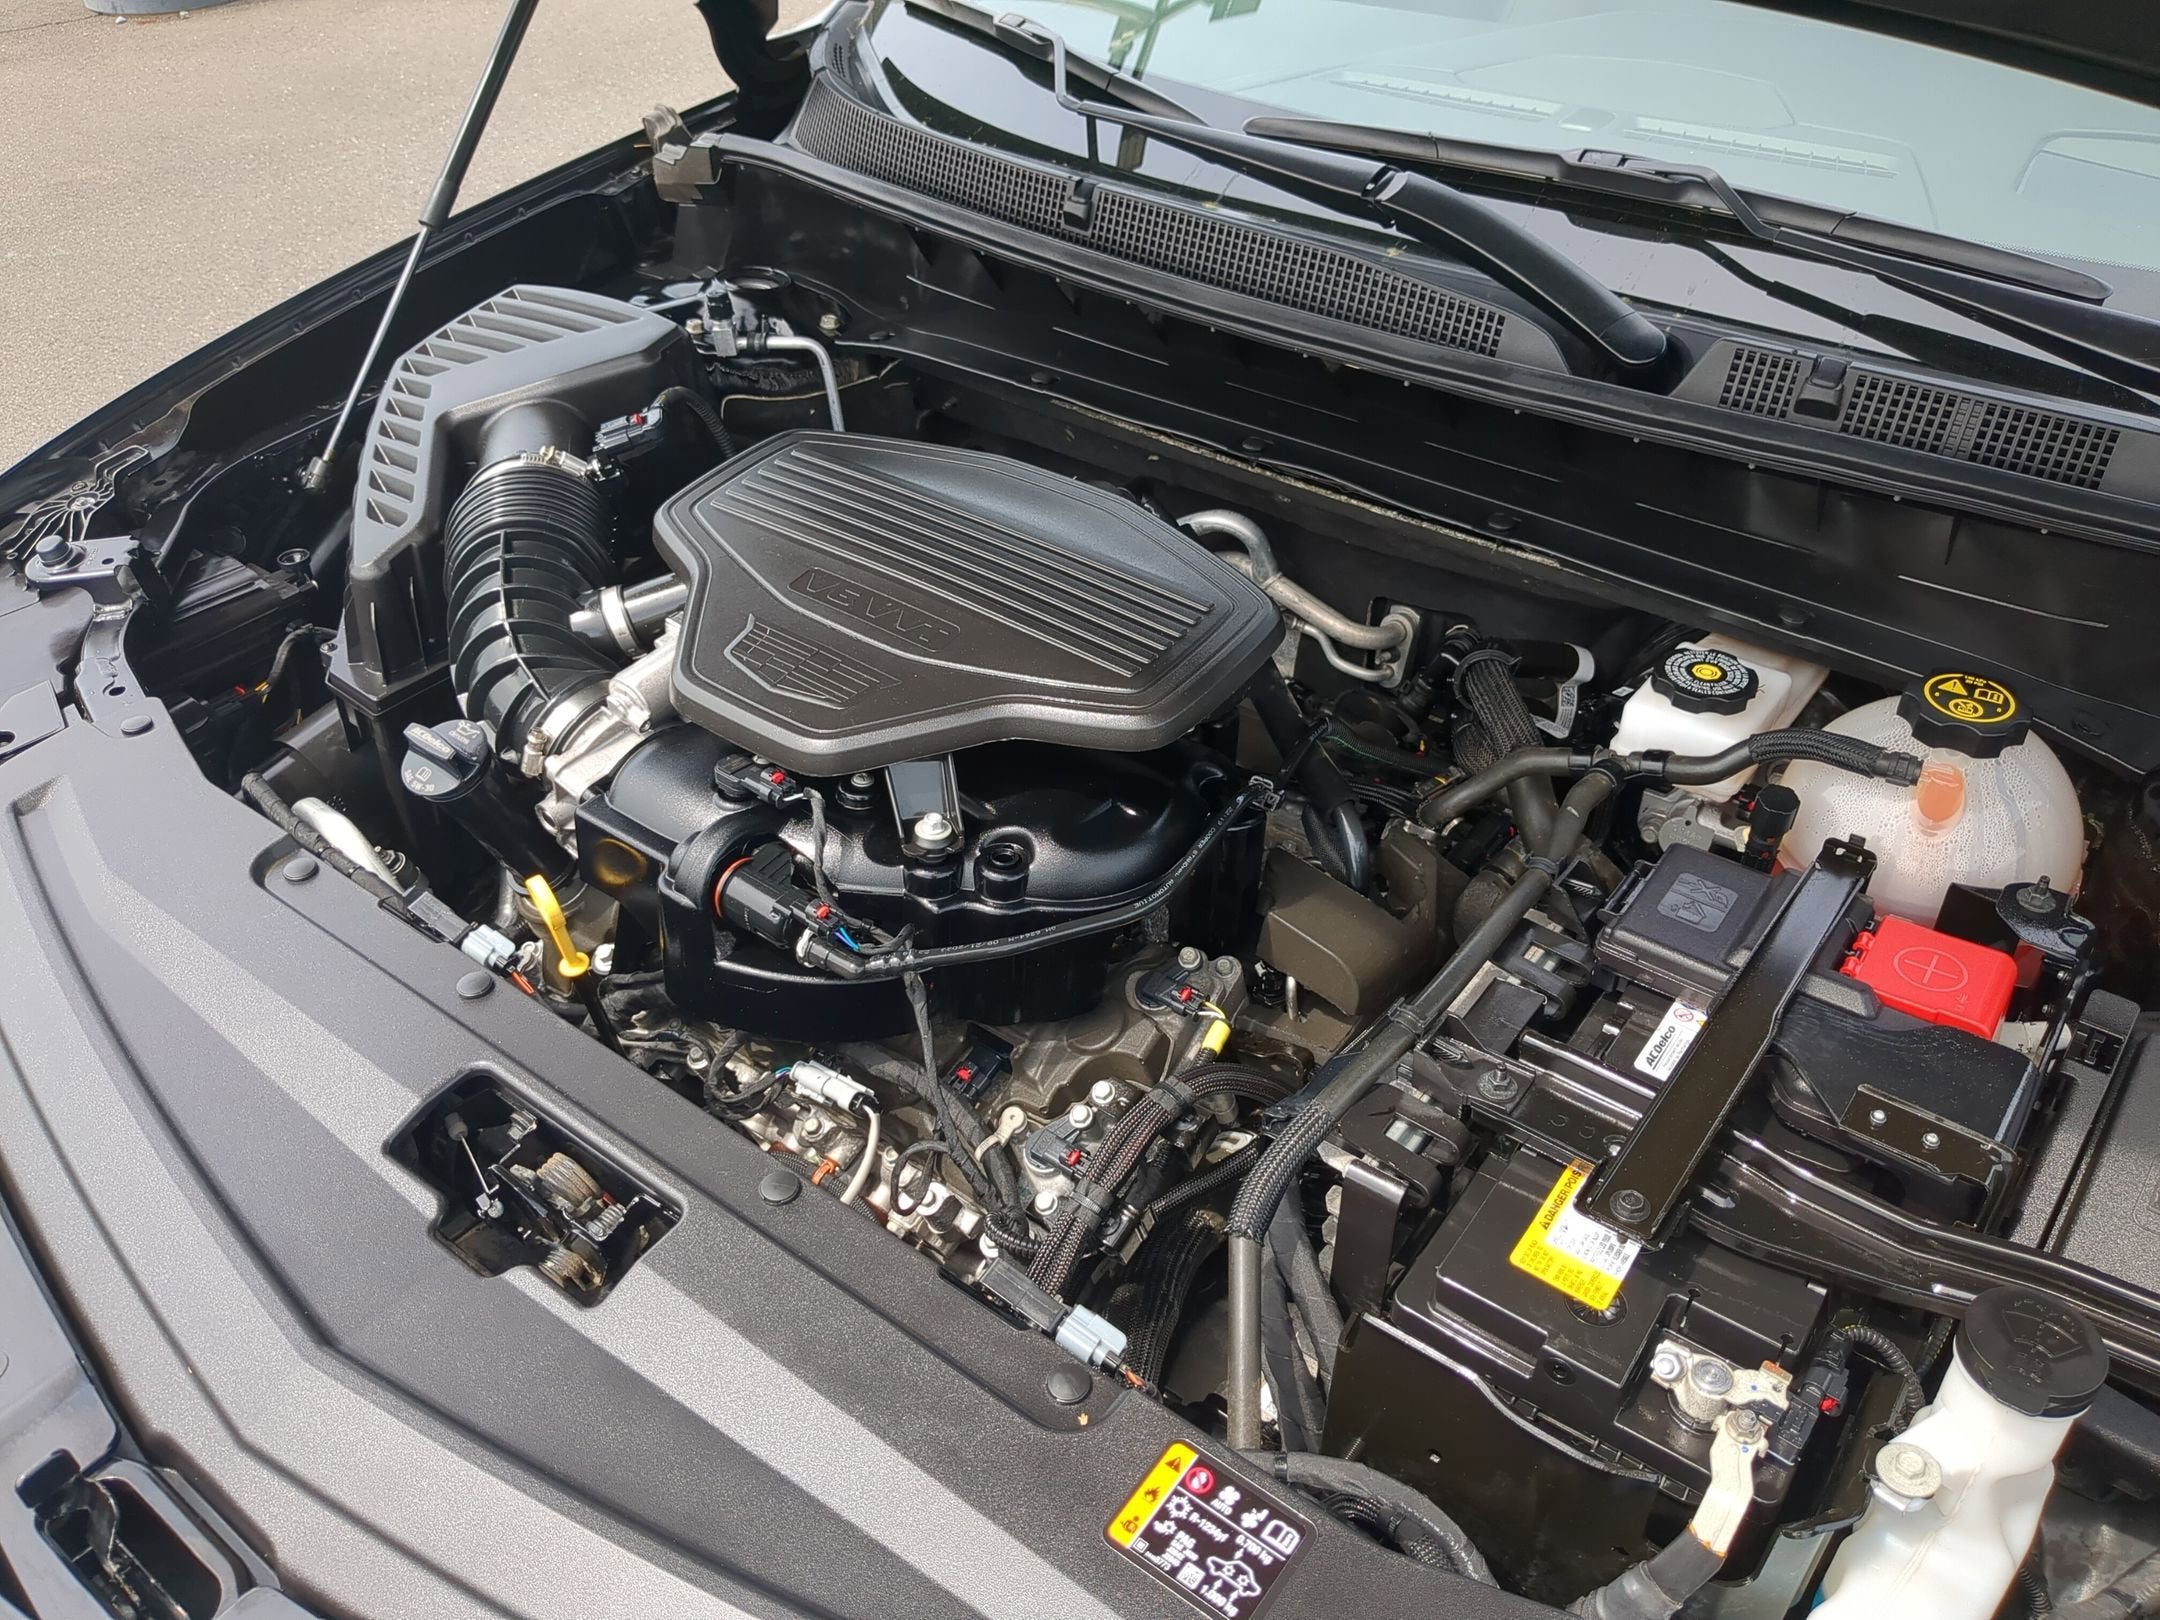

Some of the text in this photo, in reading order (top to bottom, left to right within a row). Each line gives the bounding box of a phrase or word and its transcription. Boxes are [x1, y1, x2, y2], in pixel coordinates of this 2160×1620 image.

[806, 572, 862, 607] V6
[408, 727, 451, 754] ACDelco
[1198, 827, 1217, 849] COOPER
[1134, 878, 1175, 909] AUTOMOTIVE
[1645, 1025, 1676, 1067] ACDelco
[1543, 1169, 1582, 1221] DANGER/POIS
[1210, 1498, 1233, 1516] AUTO
[1174, 1530, 1197, 1549] PAG
[1189, 1511, 1230, 1543] R-1234yf
[1258, 1552, 1275, 1566] kg
[1223, 1601, 1239, 1618] kg
